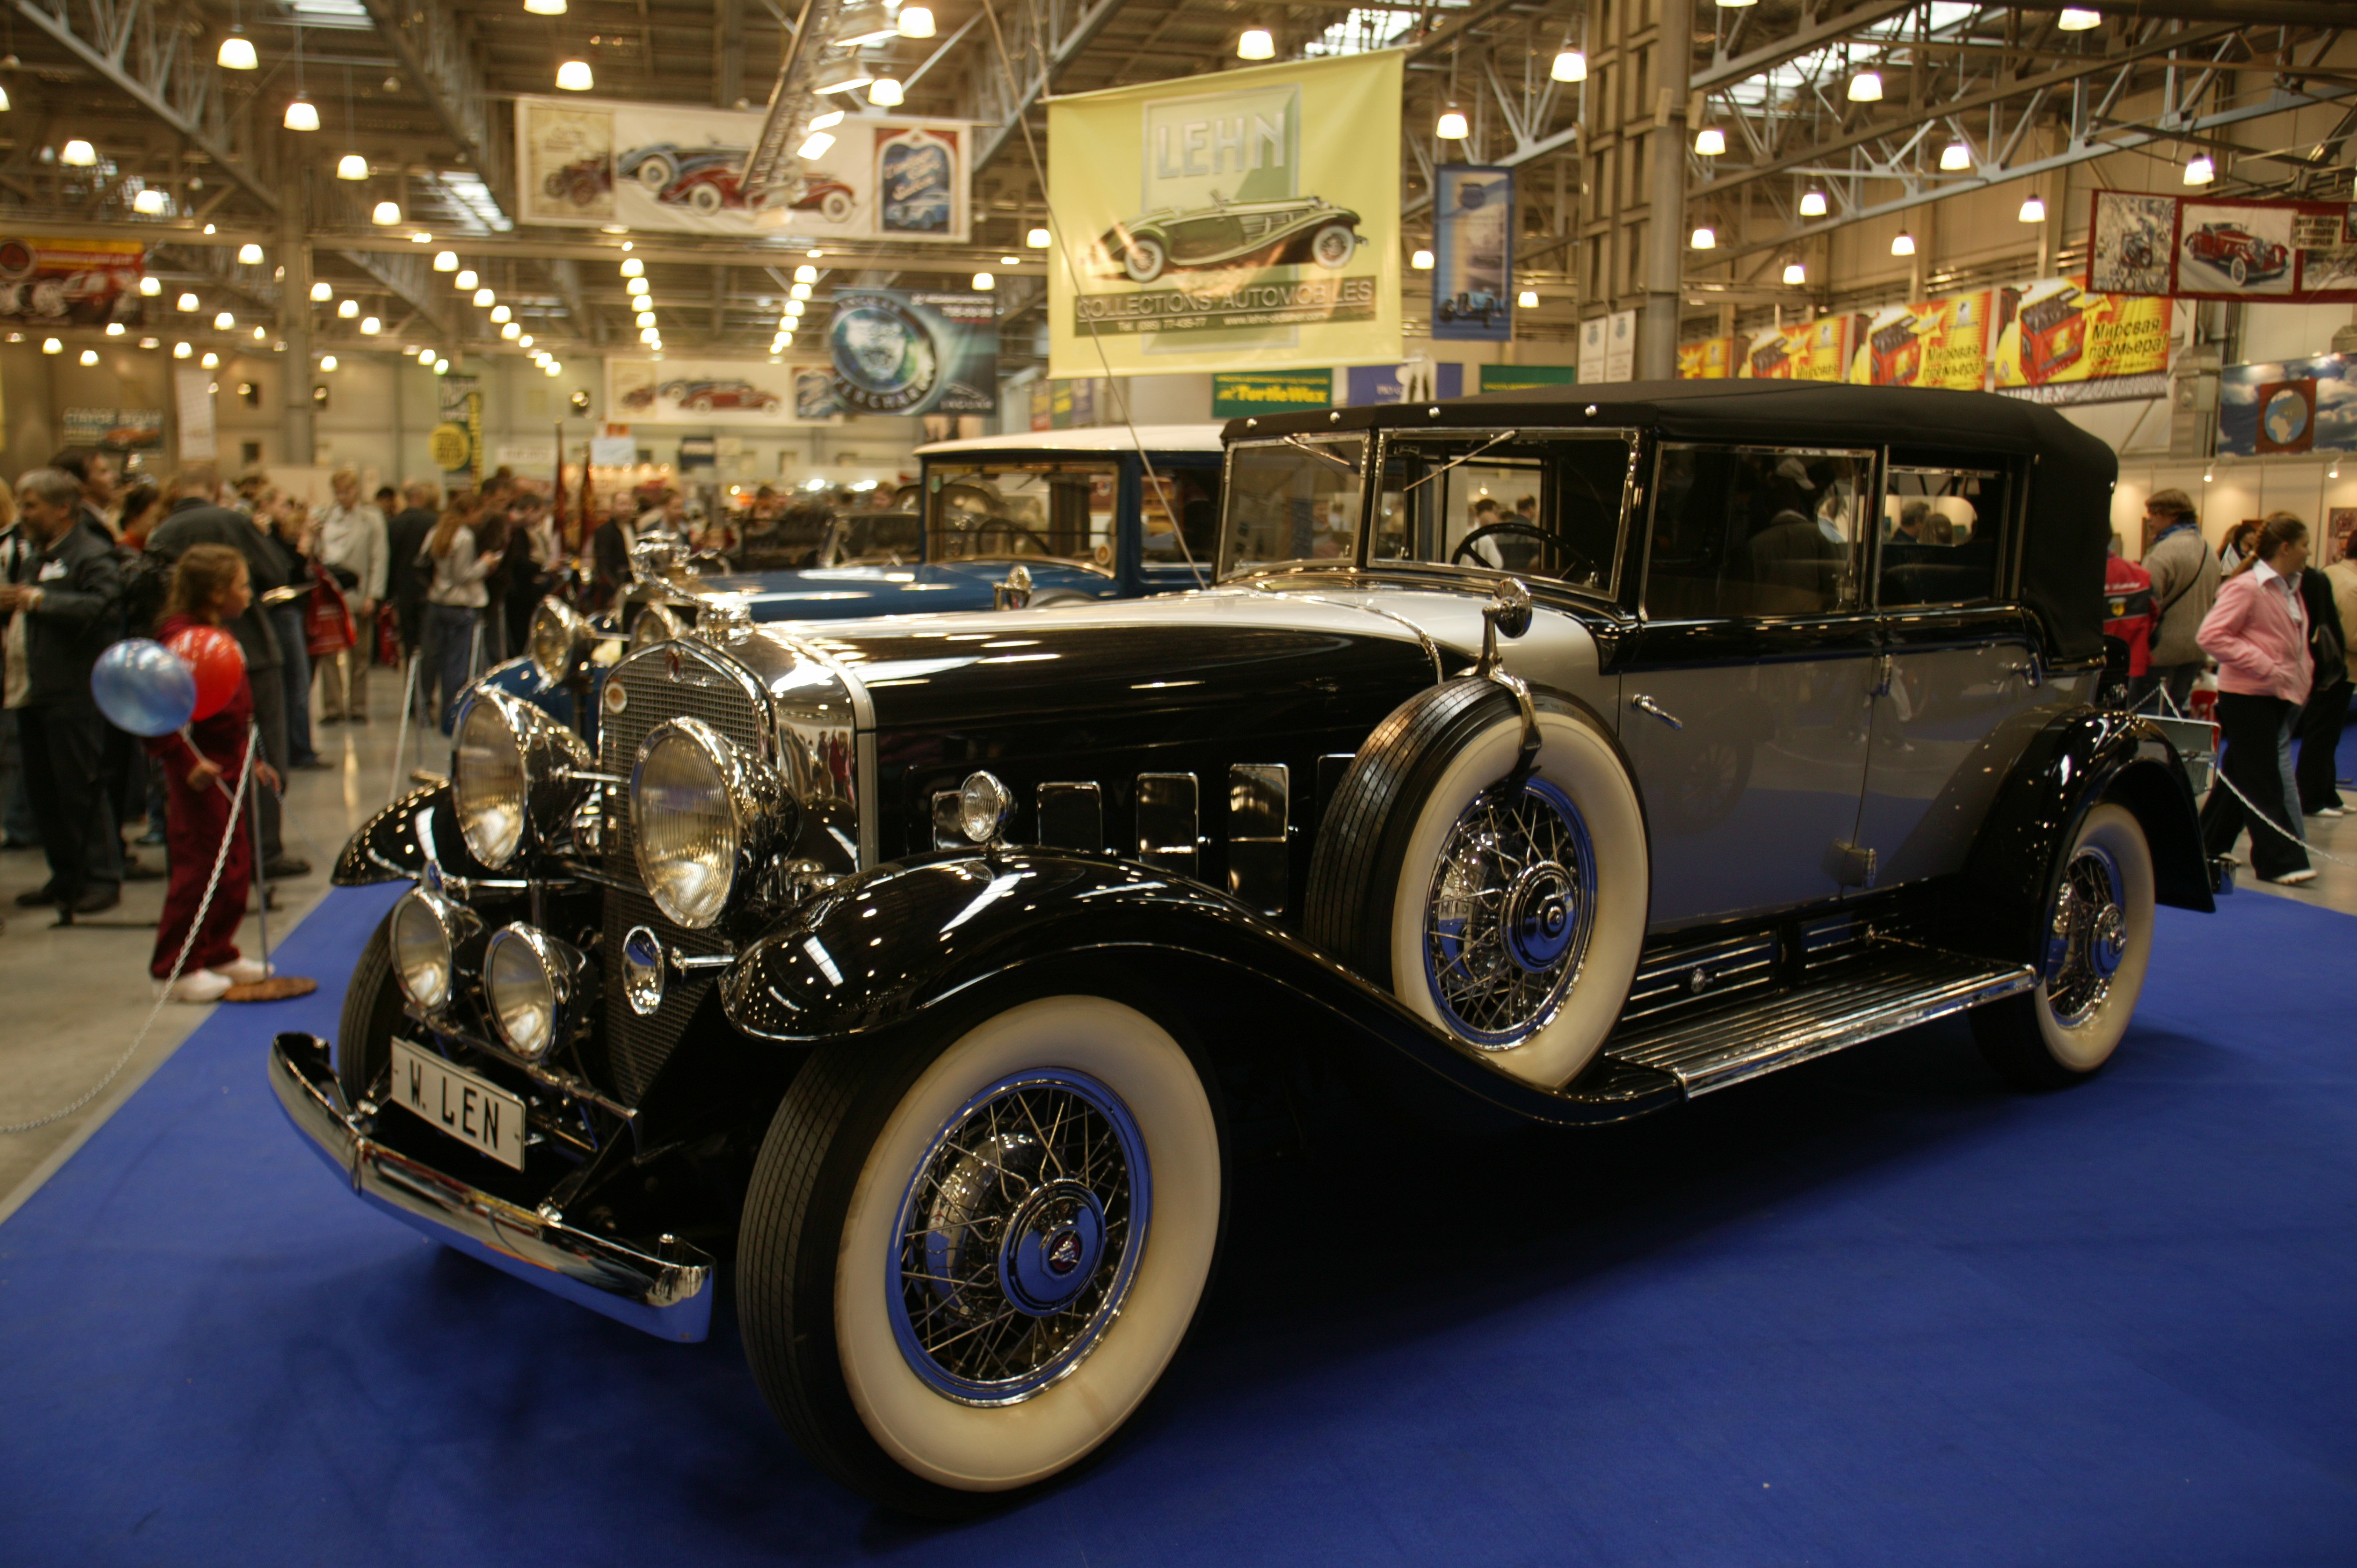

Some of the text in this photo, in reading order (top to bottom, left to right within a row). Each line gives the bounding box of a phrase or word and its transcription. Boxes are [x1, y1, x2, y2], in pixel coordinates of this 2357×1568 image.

[1157, 111, 1286, 179] LEHN
[1077, 280, 1373, 318] COLLECTIONS AUTOMOBILES
[409, 1059, 499, 1149] W. LEN
